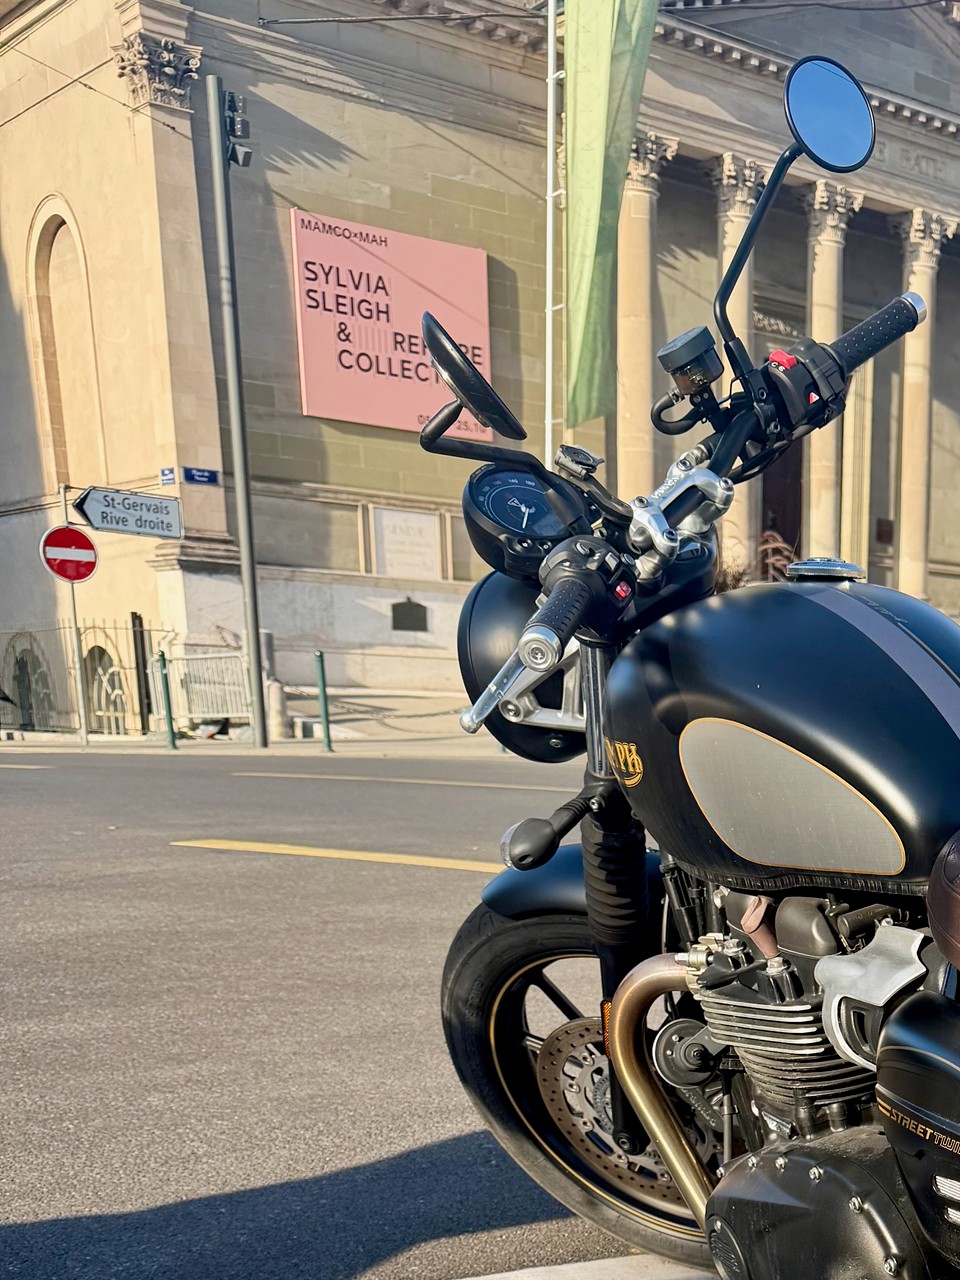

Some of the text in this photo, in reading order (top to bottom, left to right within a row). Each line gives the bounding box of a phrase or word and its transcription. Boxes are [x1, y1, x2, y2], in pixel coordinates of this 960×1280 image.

[304, 260, 390, 297] SYLVIA
[305, 288, 390, 323] SLEIGH
[337, 321, 352, 344] &
[102, 494, 170, 515] St-Gervais
[100, 511, 173, 532] Rive droite
[890, 1108, 934, 1140] STREET
